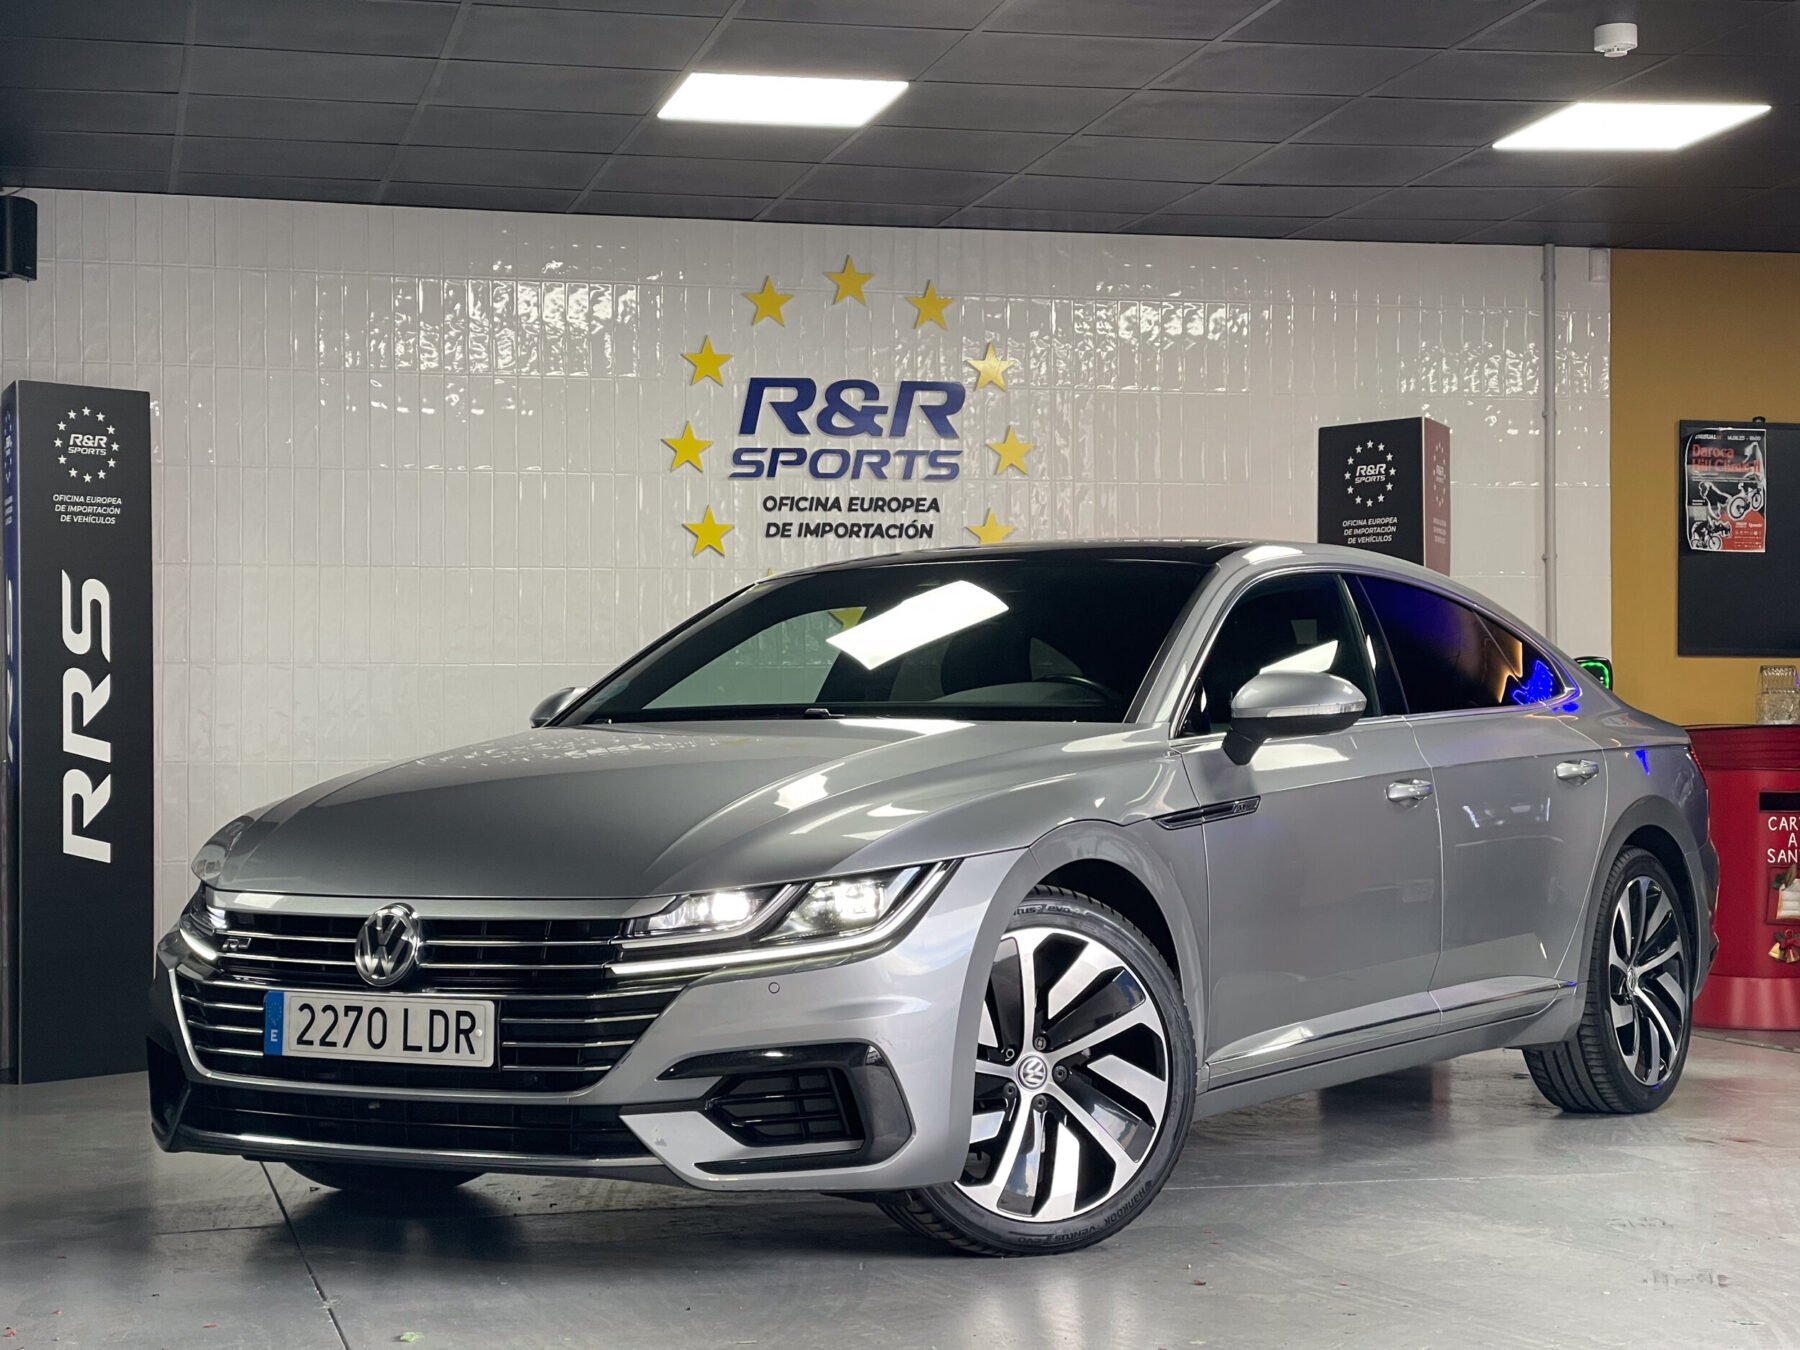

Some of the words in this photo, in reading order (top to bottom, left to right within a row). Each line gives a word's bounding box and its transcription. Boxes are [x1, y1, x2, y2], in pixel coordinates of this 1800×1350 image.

[738, 377, 967, 439] R&R
[69, 433, 108, 448] R&R
[67, 446, 108, 456] SPORTS
[1692, 444, 1735, 459] Daroca
[728, 447, 964, 481] SPORTS
[1355, 463, 1387, 477] R&R
[1354, 474, 1386, 484] SPORTS
[52, 494, 85, 503] OFICINA
[85, 495, 122, 505] EUROPEA
[762, 495, 842, 513] OFICINA
[847, 496, 941, 514] EUROPEA
[54, 504, 67, 512] DE
[67, 504, 121, 515] IMPORTACIÓN
[60, 514, 72, 523] DE
[72, 513, 116, 525] VEHÍCULOS
[1342, 518, 1367, 528] OFICINA
[1367, 516, 1398, 526] EUROPEA
[765, 522, 793, 539] DE
[797, 519, 934, 540] IMPORTACIÓN
[1343, 527, 1353, 537] DE
[1353, 525, 1397, 535] IMPORTACIÓN
[1347, 536, 1357, 545] DE
[1357, 533, 1393, 544] VEHÍCULOS
[62, 568, 111, 864] RRS
[1768, 816, 1800, 831] CAR
[1788, 832, 1798, 848] A
[1767, 848, 1800, 864] SAN
[270, 1029, 279, 1043] E
[296, 1003, 388, 1050] 2270
[402, 1008, 477, 1055] LDR
